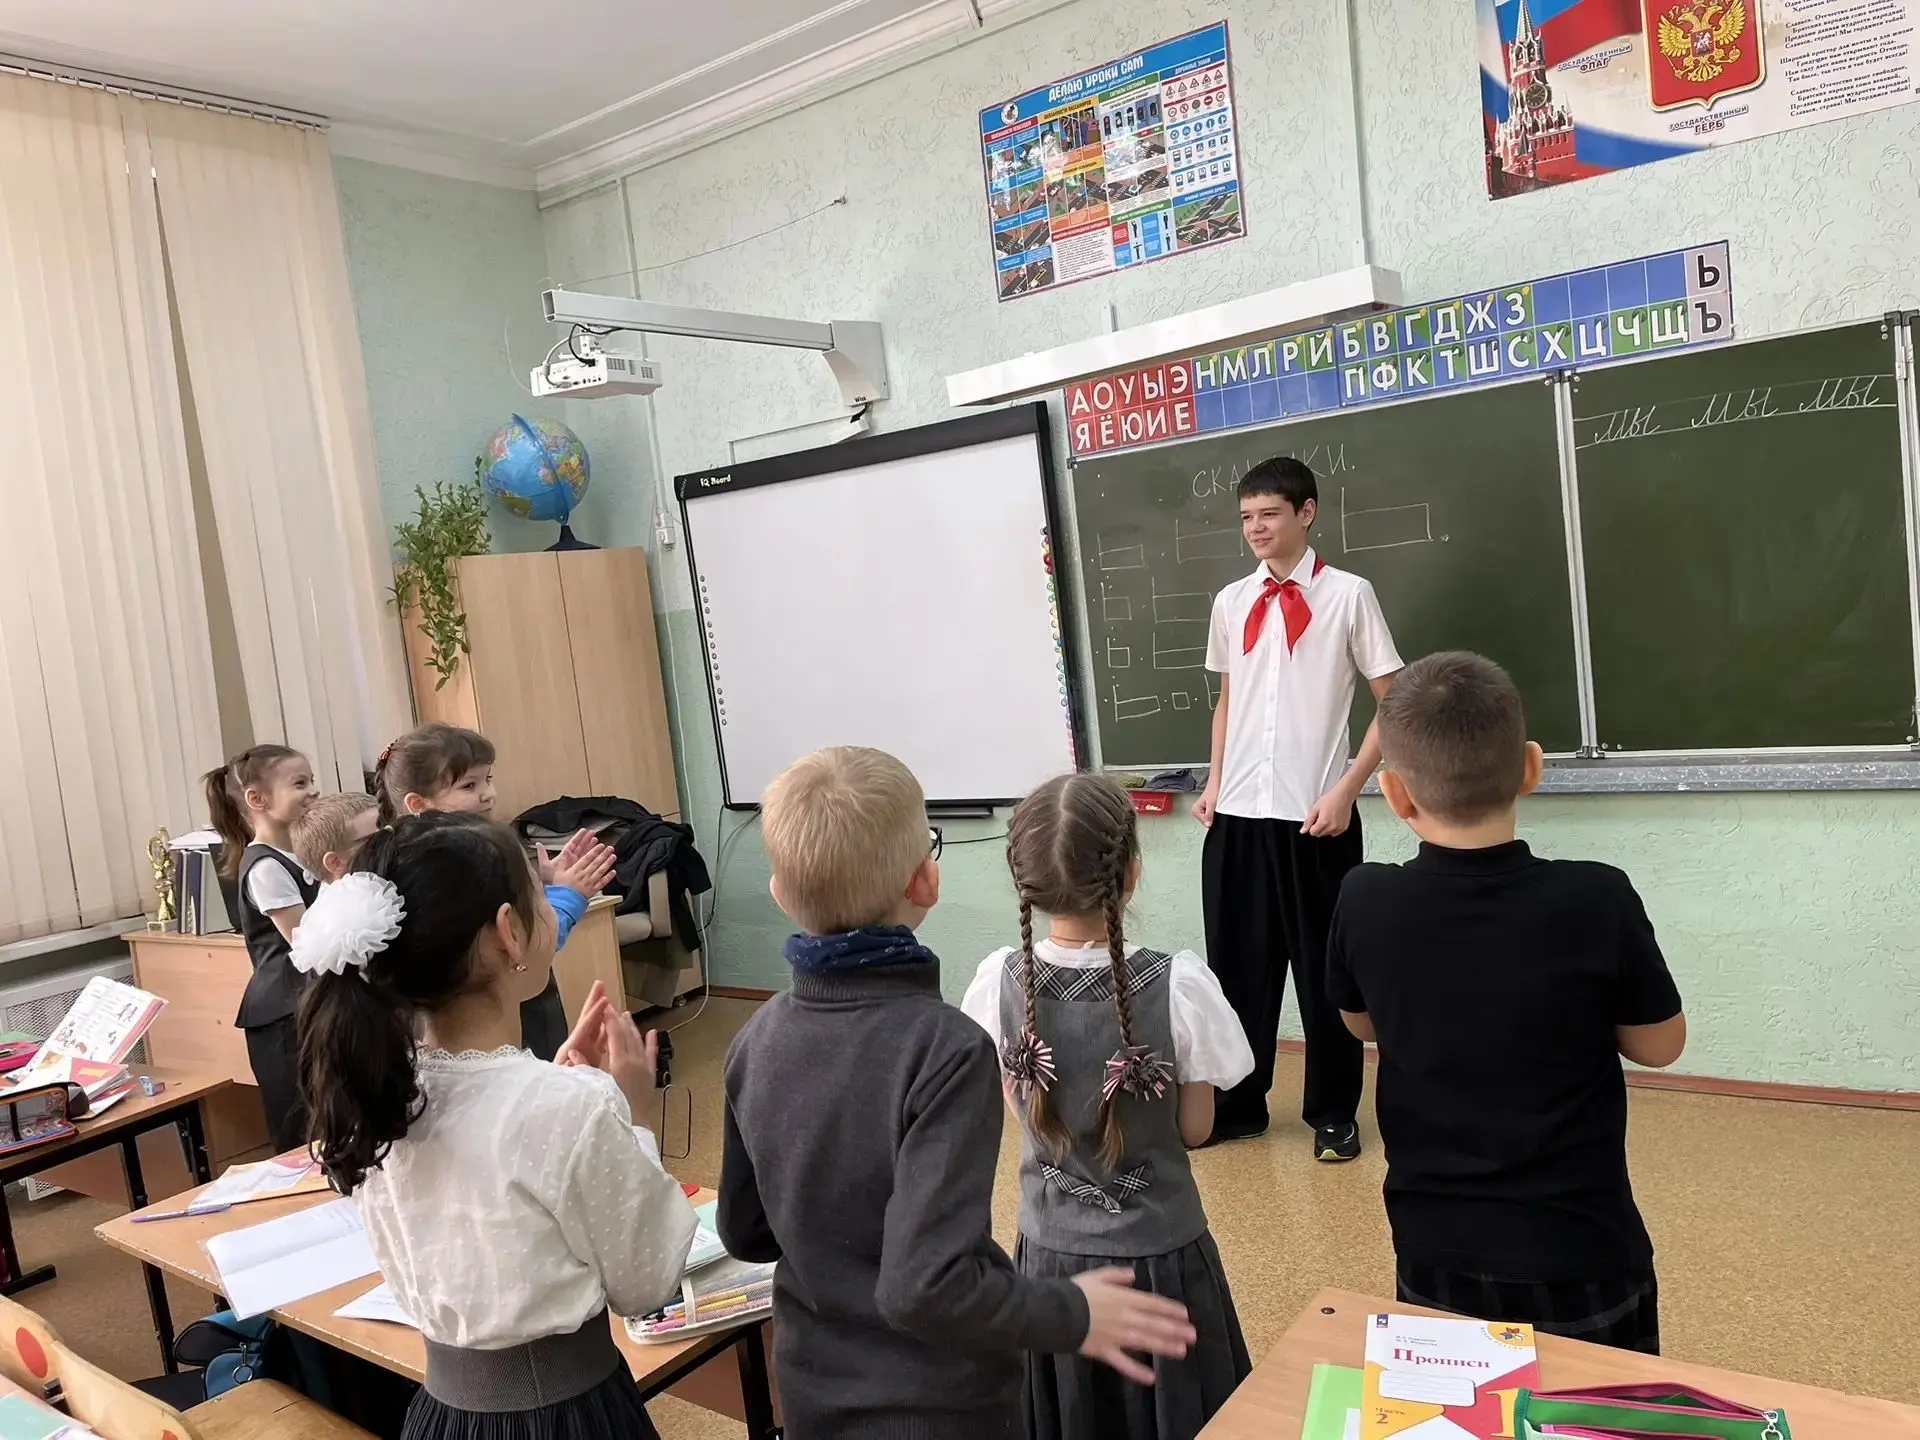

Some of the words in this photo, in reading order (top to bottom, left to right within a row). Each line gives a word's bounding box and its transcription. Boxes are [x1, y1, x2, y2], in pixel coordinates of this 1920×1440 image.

[1558, 44, 1631, 70] ГОСУДАРСТВЕННЫЙ
[1580, 58, 1610, 72] ФЛАГ
[1048, 78, 1083, 102] ДЕЛАЮ
[1086, 65, 1118, 88] УРОКИ
[1120, 55, 1144, 74] САМ
[1670, 106, 1748, 130] ГОСУДАРСТВЕННЫЙ
[1695, 120, 1724, 134] ГЕРБ
[1192, 444, 1356, 498] СКАКИ.
[700, 478, 710, 487] IQ
[711, 474, 731, 485] Board
[1394, 1348, 1490, 1368] Прописи
[1376, 1407, 1406, 1416] Часть
[1376, 1414, 1388, 1424] 2
